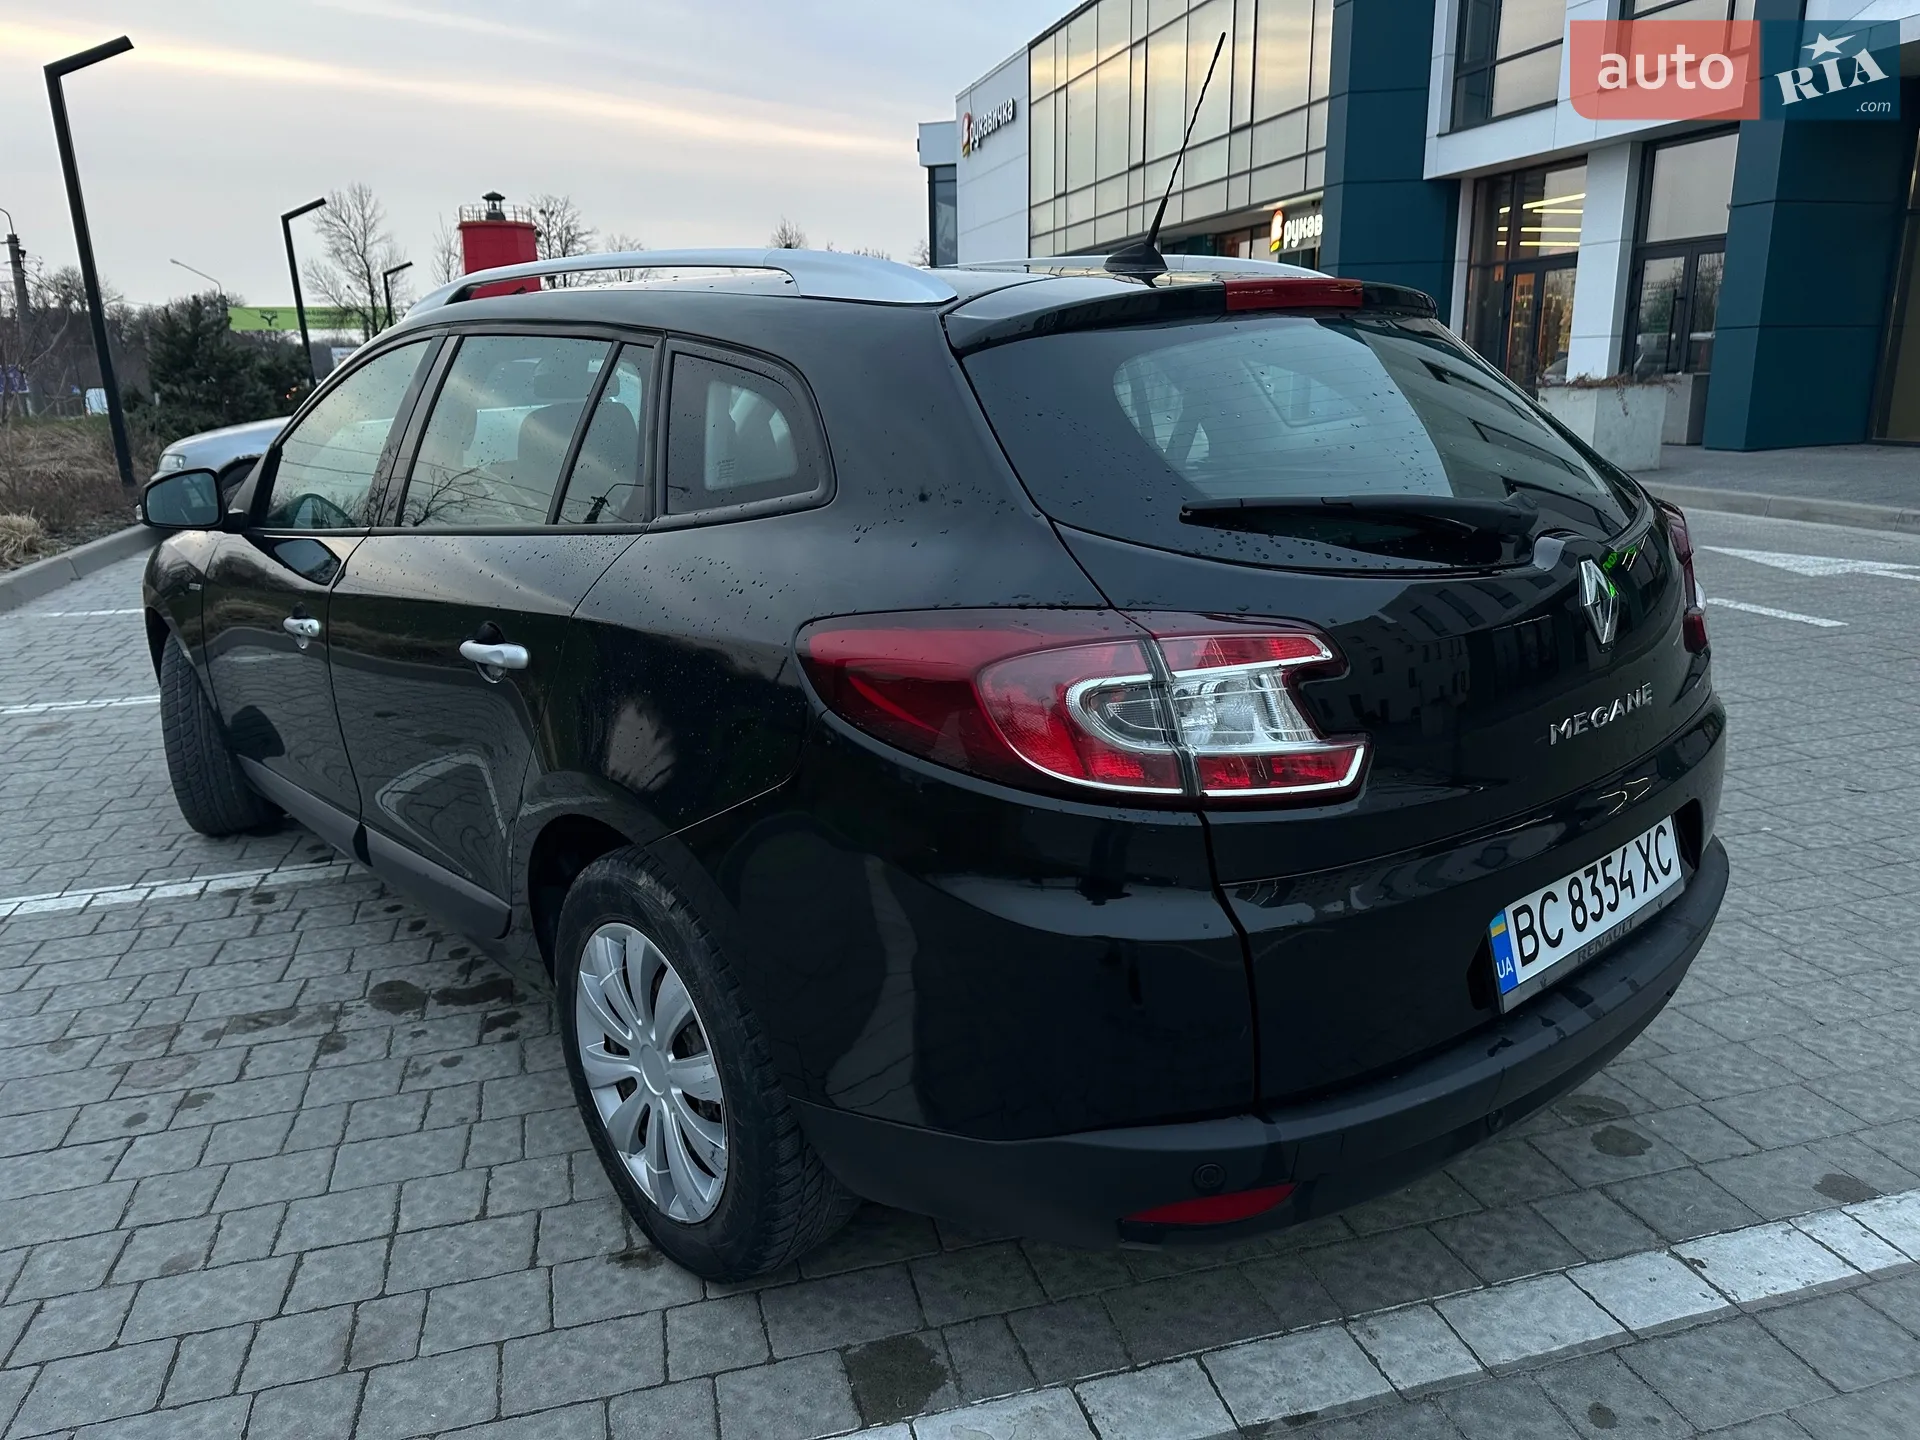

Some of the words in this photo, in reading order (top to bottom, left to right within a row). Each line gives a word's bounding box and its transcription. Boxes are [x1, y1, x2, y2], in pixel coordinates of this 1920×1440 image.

[970, 98, 1014, 151] рукавичка
[1550, 682, 1653, 745] MEGANE
[1512, 891, 1564, 967] BC
[1567, 848, 1636, 932] 8354
[1635, 824, 1672, 893] XC
[1577, 916, 1636, 963] RENAULT
[1497, 956, 1514, 978] UA
